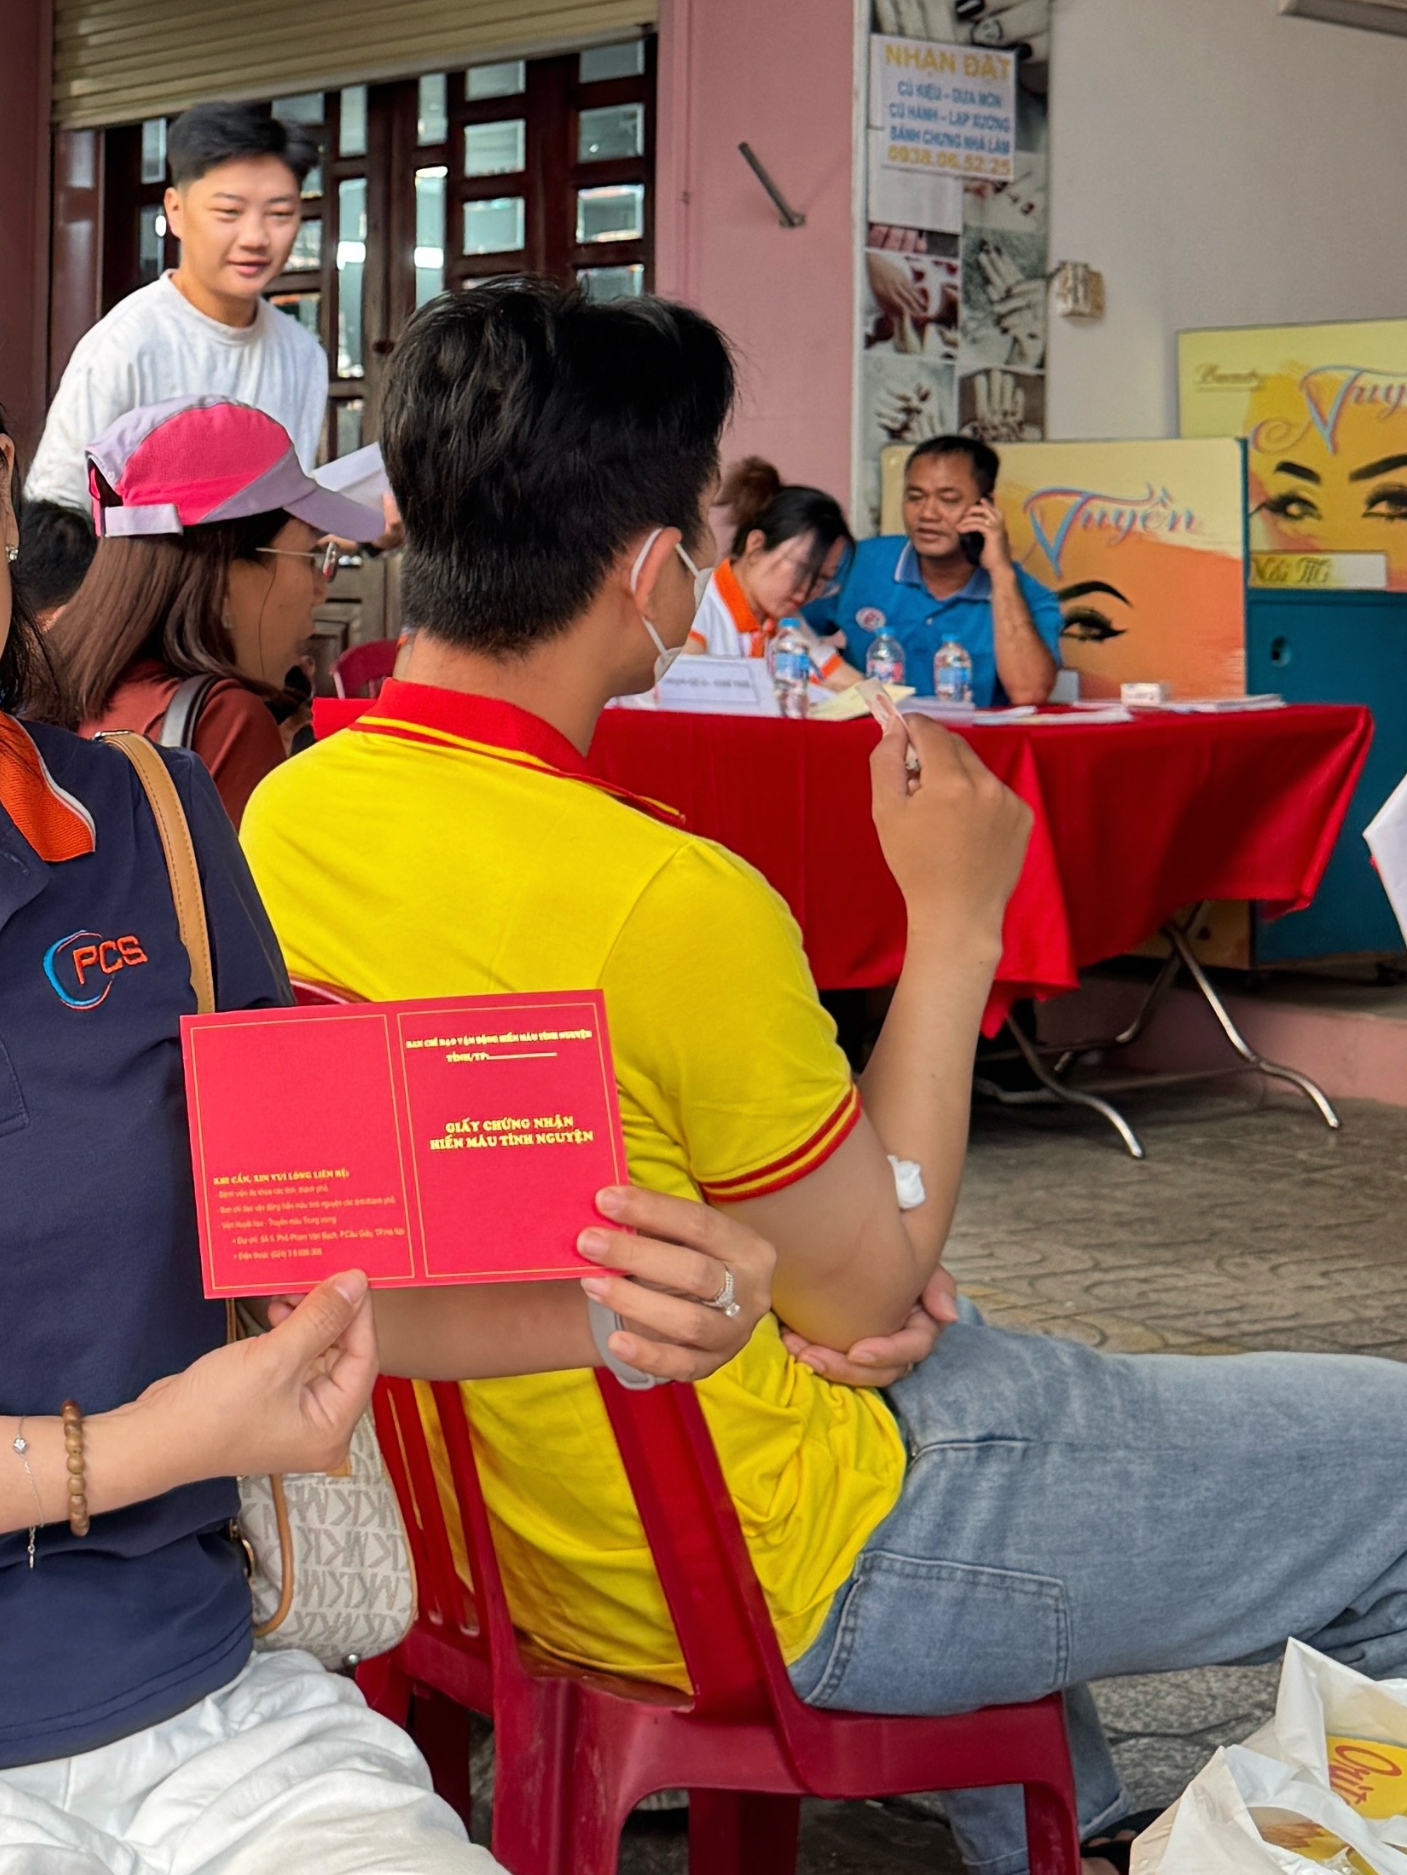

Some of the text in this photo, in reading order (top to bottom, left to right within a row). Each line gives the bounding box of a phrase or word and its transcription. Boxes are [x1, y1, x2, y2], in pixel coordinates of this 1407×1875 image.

[72, 935, 148, 985] PCS
[482, 1116, 531, 1132] CHỨNG
[533, 1113, 574, 1129] NHẬN
[429, 1133, 464, 1150] HIẾN
